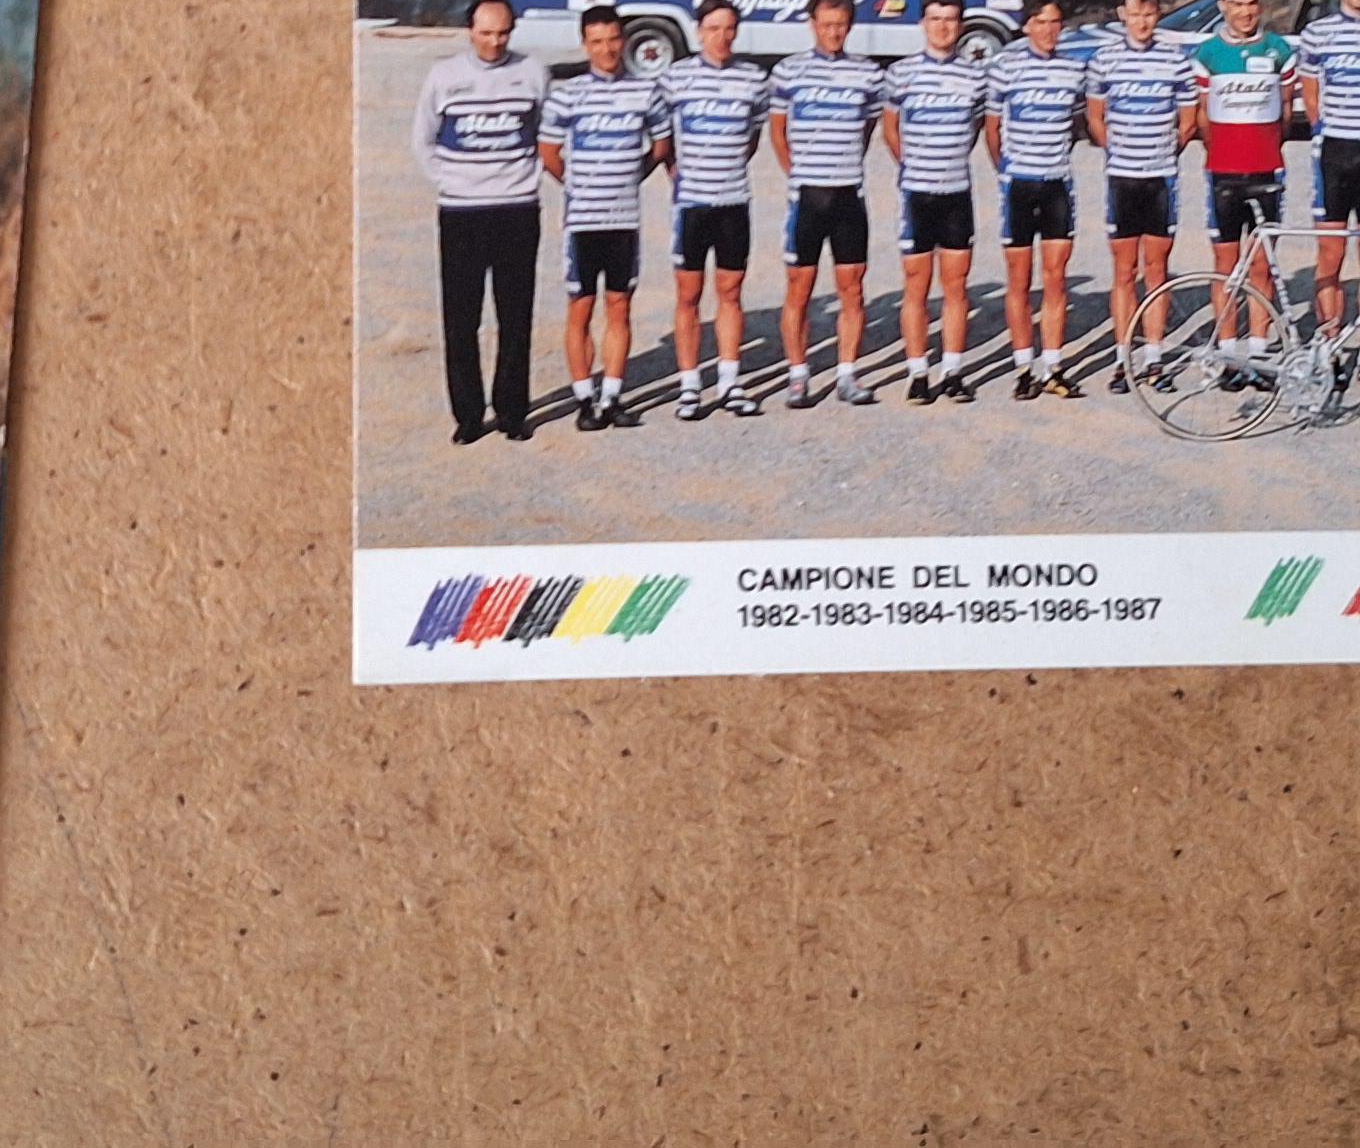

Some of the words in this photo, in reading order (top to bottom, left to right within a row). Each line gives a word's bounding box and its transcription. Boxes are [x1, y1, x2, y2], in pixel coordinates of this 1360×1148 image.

[738, 566, 895, 592] CAMPIONE
[913, 564, 970, 589] DEL
[988, 563, 1098, 588] MONDO
[738, 598, 1162, 628] 1982-1983-1984-1985-1986-1987
